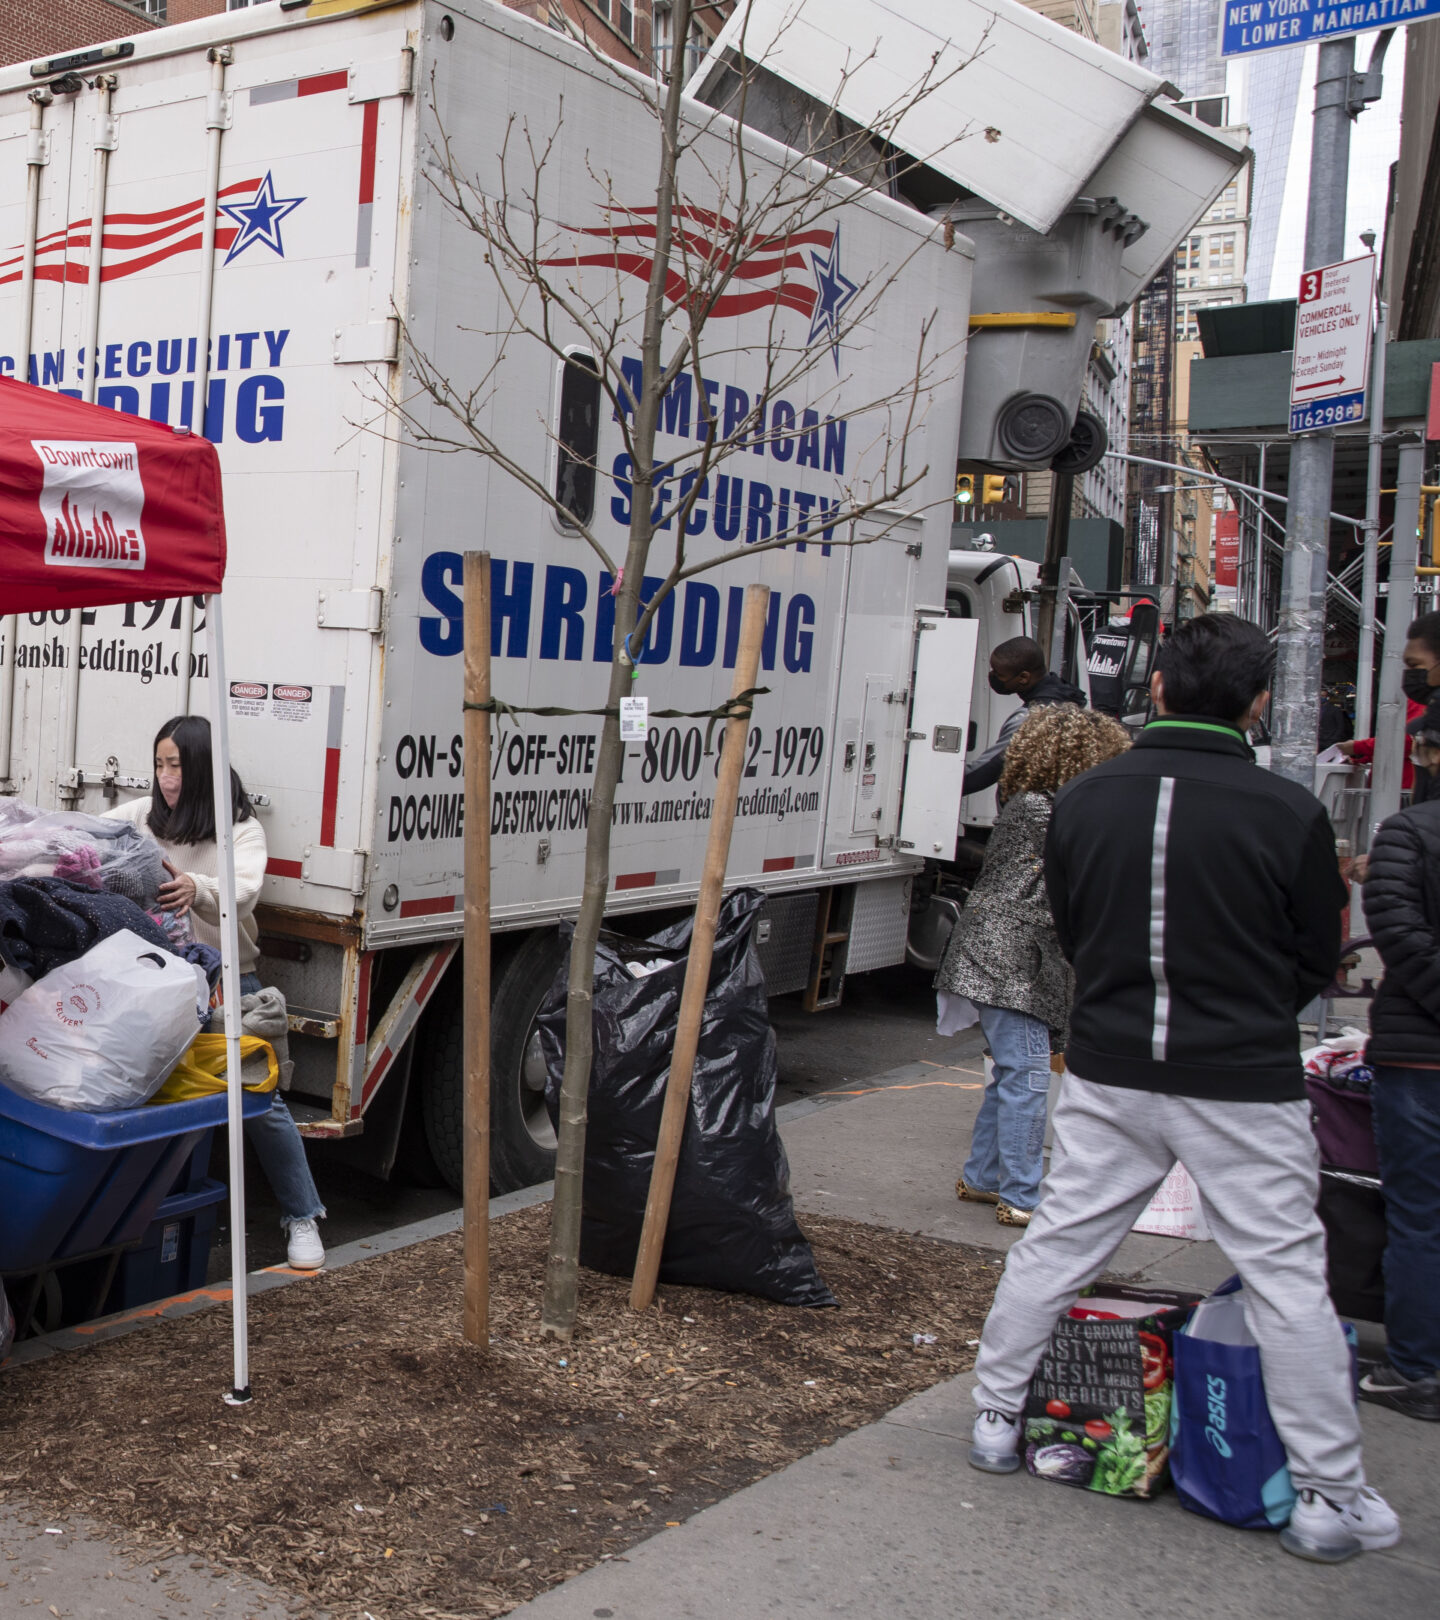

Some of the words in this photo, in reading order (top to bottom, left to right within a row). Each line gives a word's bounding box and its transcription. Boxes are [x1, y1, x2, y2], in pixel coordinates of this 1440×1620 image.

[1229, 4, 1260, 26] NEW
[1269, 0, 1310, 18] YORK
[1241, 18, 1302, 46] LOWER
[1312, 0, 1428, 33] MANHATTAN
[1304, 274, 1317, 300] 3
[1323, 286, 1346, 300] parking
[1324, 275, 1350, 289] metered
[1300, 302, 1352, 326] COMMERCIAL
[1299, 319, 1337, 339] VEHICLES
[1339, 314, 1360, 330] ONLY
[1297, 354, 1311, 366] 7am
[1317, 346, 1347, 361] Midnight
[1296, 366, 1319, 378] Except
[1319, 359, 1344, 374] Sunday
[612, 356, 847, 476] AMERICAN
[1292, 405, 1344, 430] 116298
[40, 445, 133, 471] Downtown
[611, 453, 841, 557] SECURITY
[234, 686, 263, 696] DANGER
[277, 688, 307, 698] DANGER
[388, 793, 464, 842] DOCUME
[491, 788, 593, 835] DESTRUCTION
[56, 1001, 84, 1027] DELIVERY
[1084, 1323, 1136, 1340] GROWN
[1101, 1341, 1139, 1355] HOME
[1102, 1358, 1138, 1371] MADE
[1104, 1372, 1140, 1389] MEALS
[1033, 1378, 1142, 1410] INGREDIENTS
